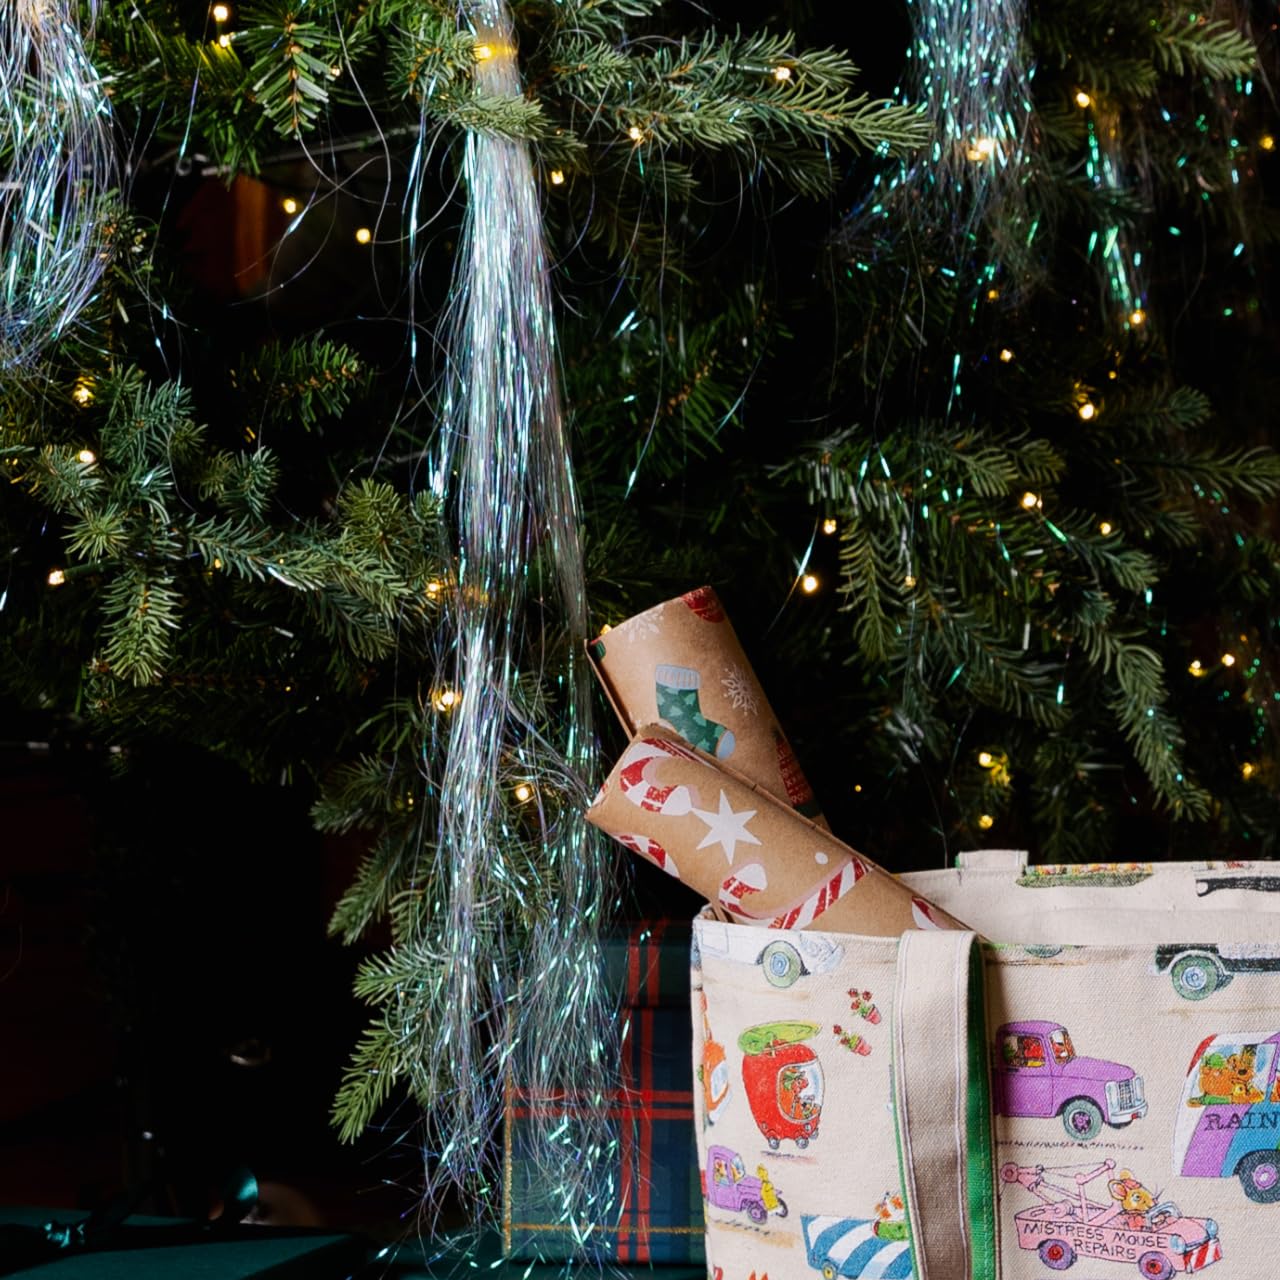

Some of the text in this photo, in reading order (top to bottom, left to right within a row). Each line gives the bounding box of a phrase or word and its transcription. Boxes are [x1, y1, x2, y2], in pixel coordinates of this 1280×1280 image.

[1023, 1222, 1168, 1249] MISTRESS MOUSE
[1073, 1238, 1137, 1260] REPAIRS
